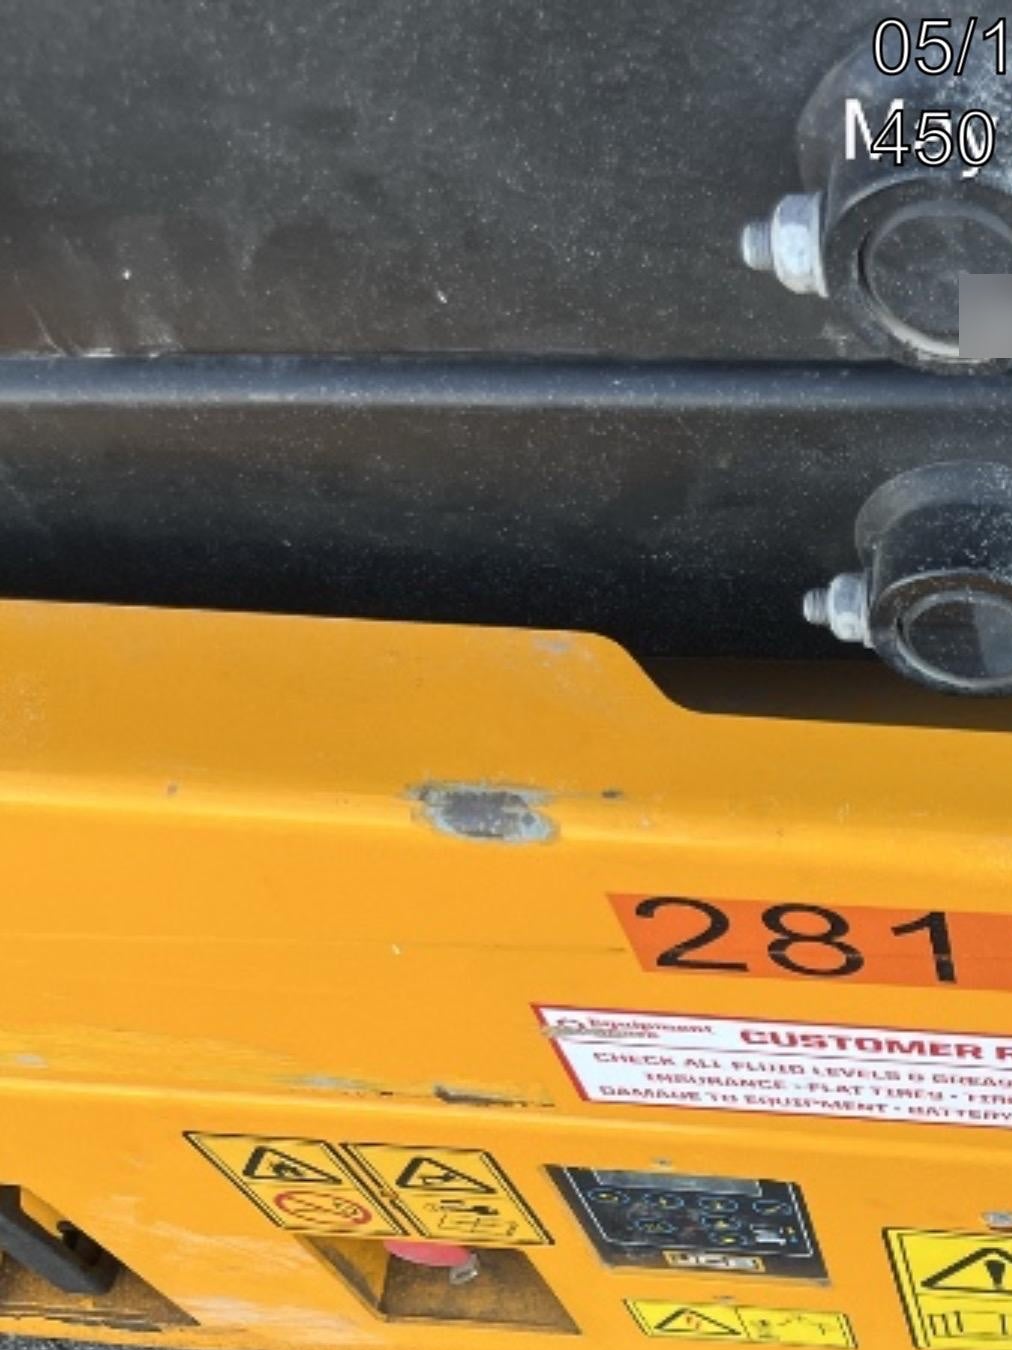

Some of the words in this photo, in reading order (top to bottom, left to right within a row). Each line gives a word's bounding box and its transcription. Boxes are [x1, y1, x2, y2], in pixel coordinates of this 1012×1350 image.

[740, 1029, 984, 1060] CUSTOMER
[593, 1052, 676, 1067] CHECK
[683, 1057, 721, 1069] ALL
[812, 1065, 901, 1081] LEVELS
